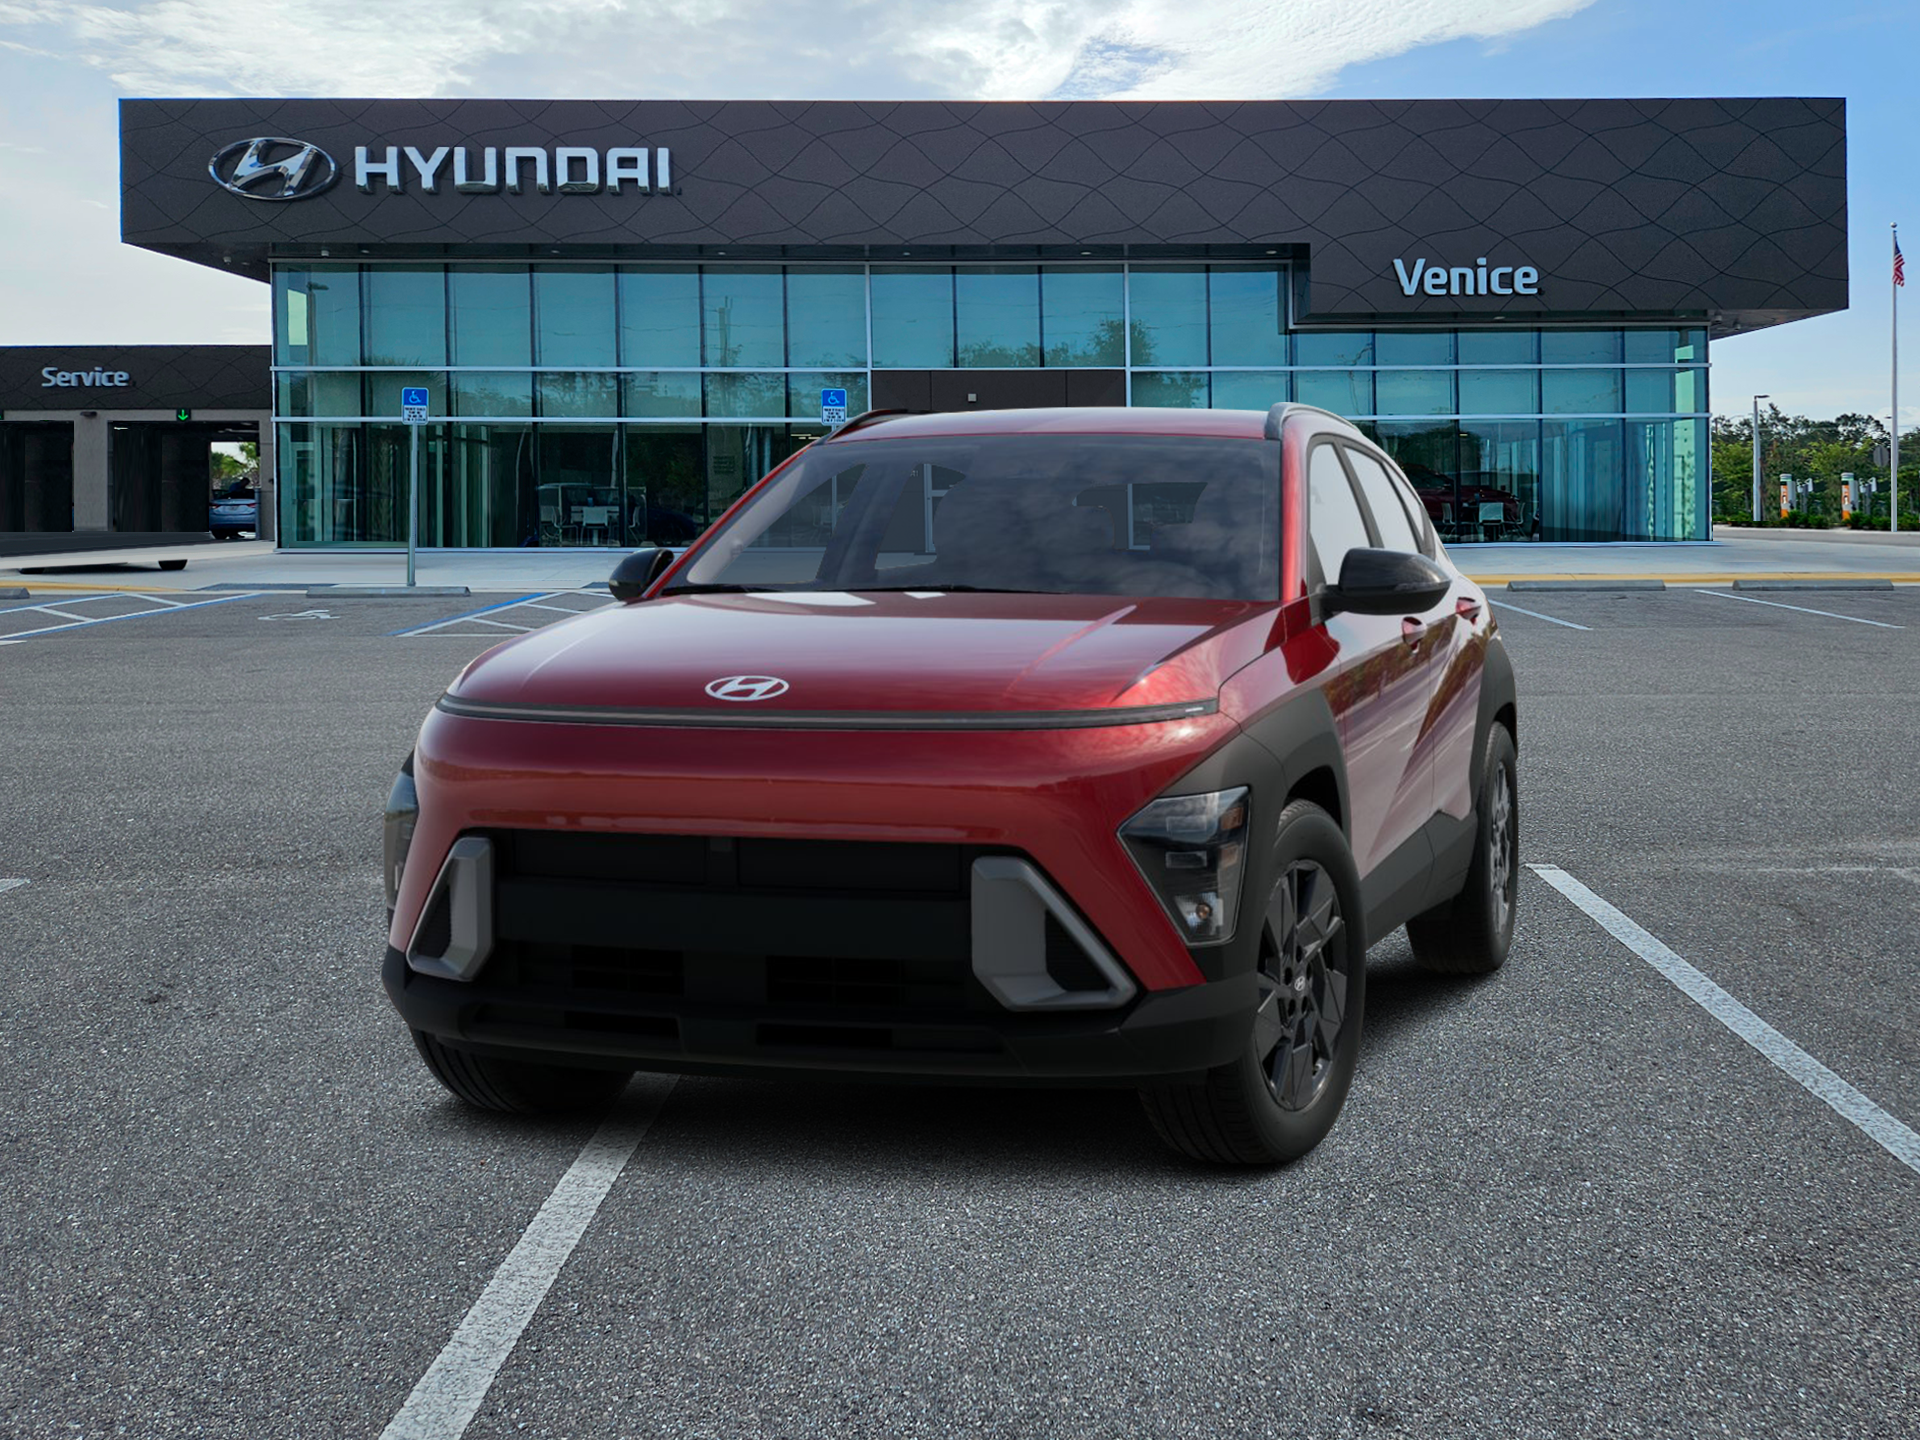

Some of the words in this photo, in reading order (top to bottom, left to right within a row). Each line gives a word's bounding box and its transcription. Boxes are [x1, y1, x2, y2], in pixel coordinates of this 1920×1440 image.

[355, 146, 671, 194] HYUNDAI
[1393, 257, 1538, 296] Venice
[41, 366, 130, 387] Service
